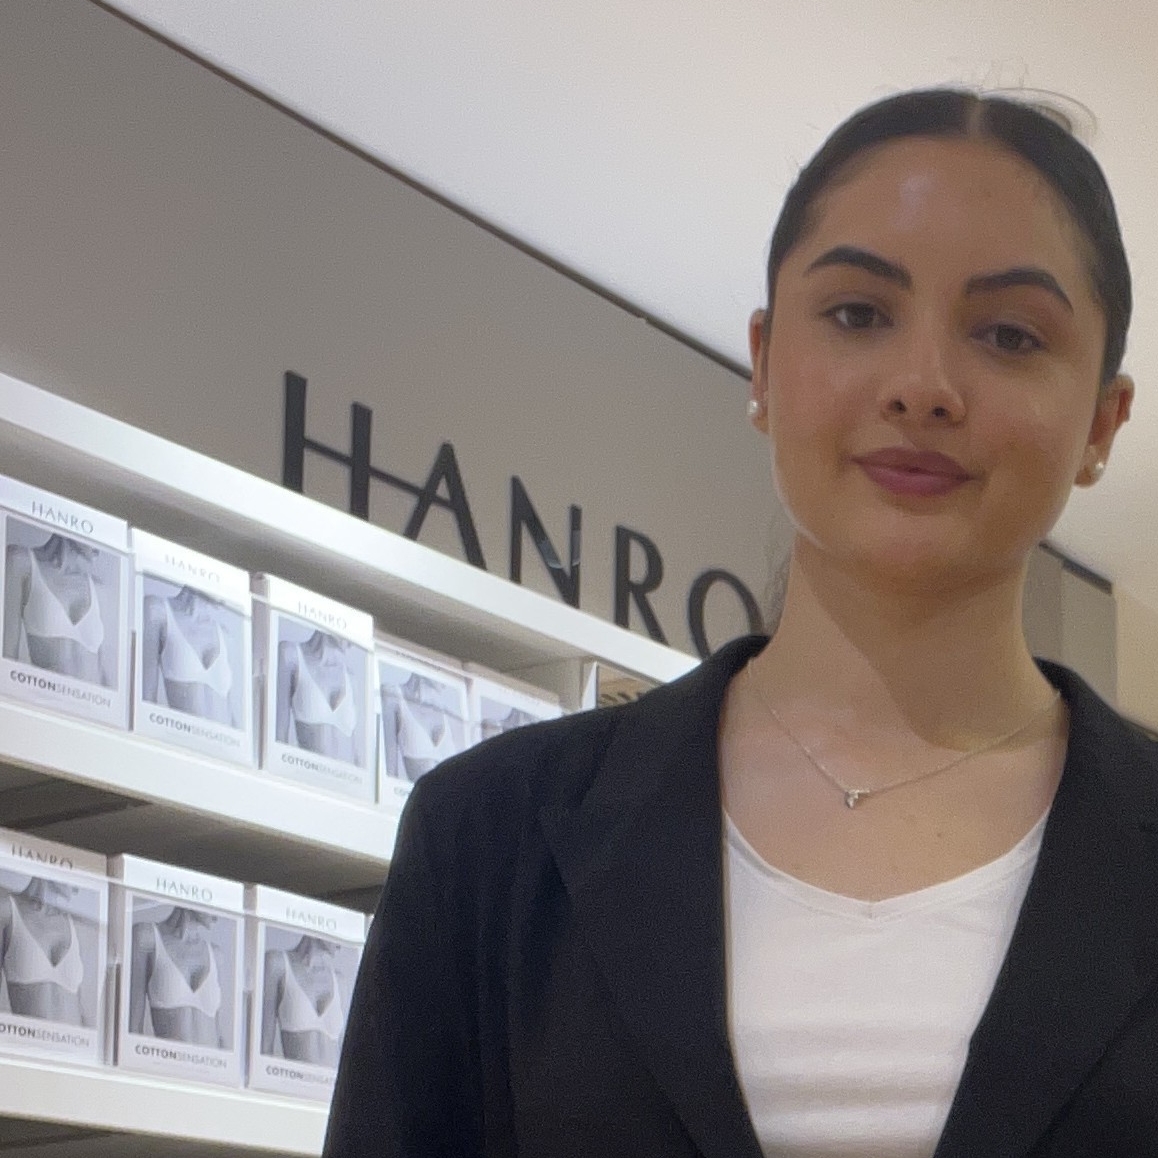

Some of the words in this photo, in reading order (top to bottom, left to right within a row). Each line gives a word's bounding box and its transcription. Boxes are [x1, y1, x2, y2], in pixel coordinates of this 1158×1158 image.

[31, 500, 94, 534] HANRO
[283, 371, 764, 659] HANRO
[10, 669, 111, 708] COTTONSENSATION
[11, 844, 74, 870] HANRO
[156, 876, 213, 902] HANRO
[285, 907, 337, 931] HANRO
[0, 1023, 89, 1047] OTTONSENSATION
[135, 1043, 227, 1069] COTTONSENSATION
